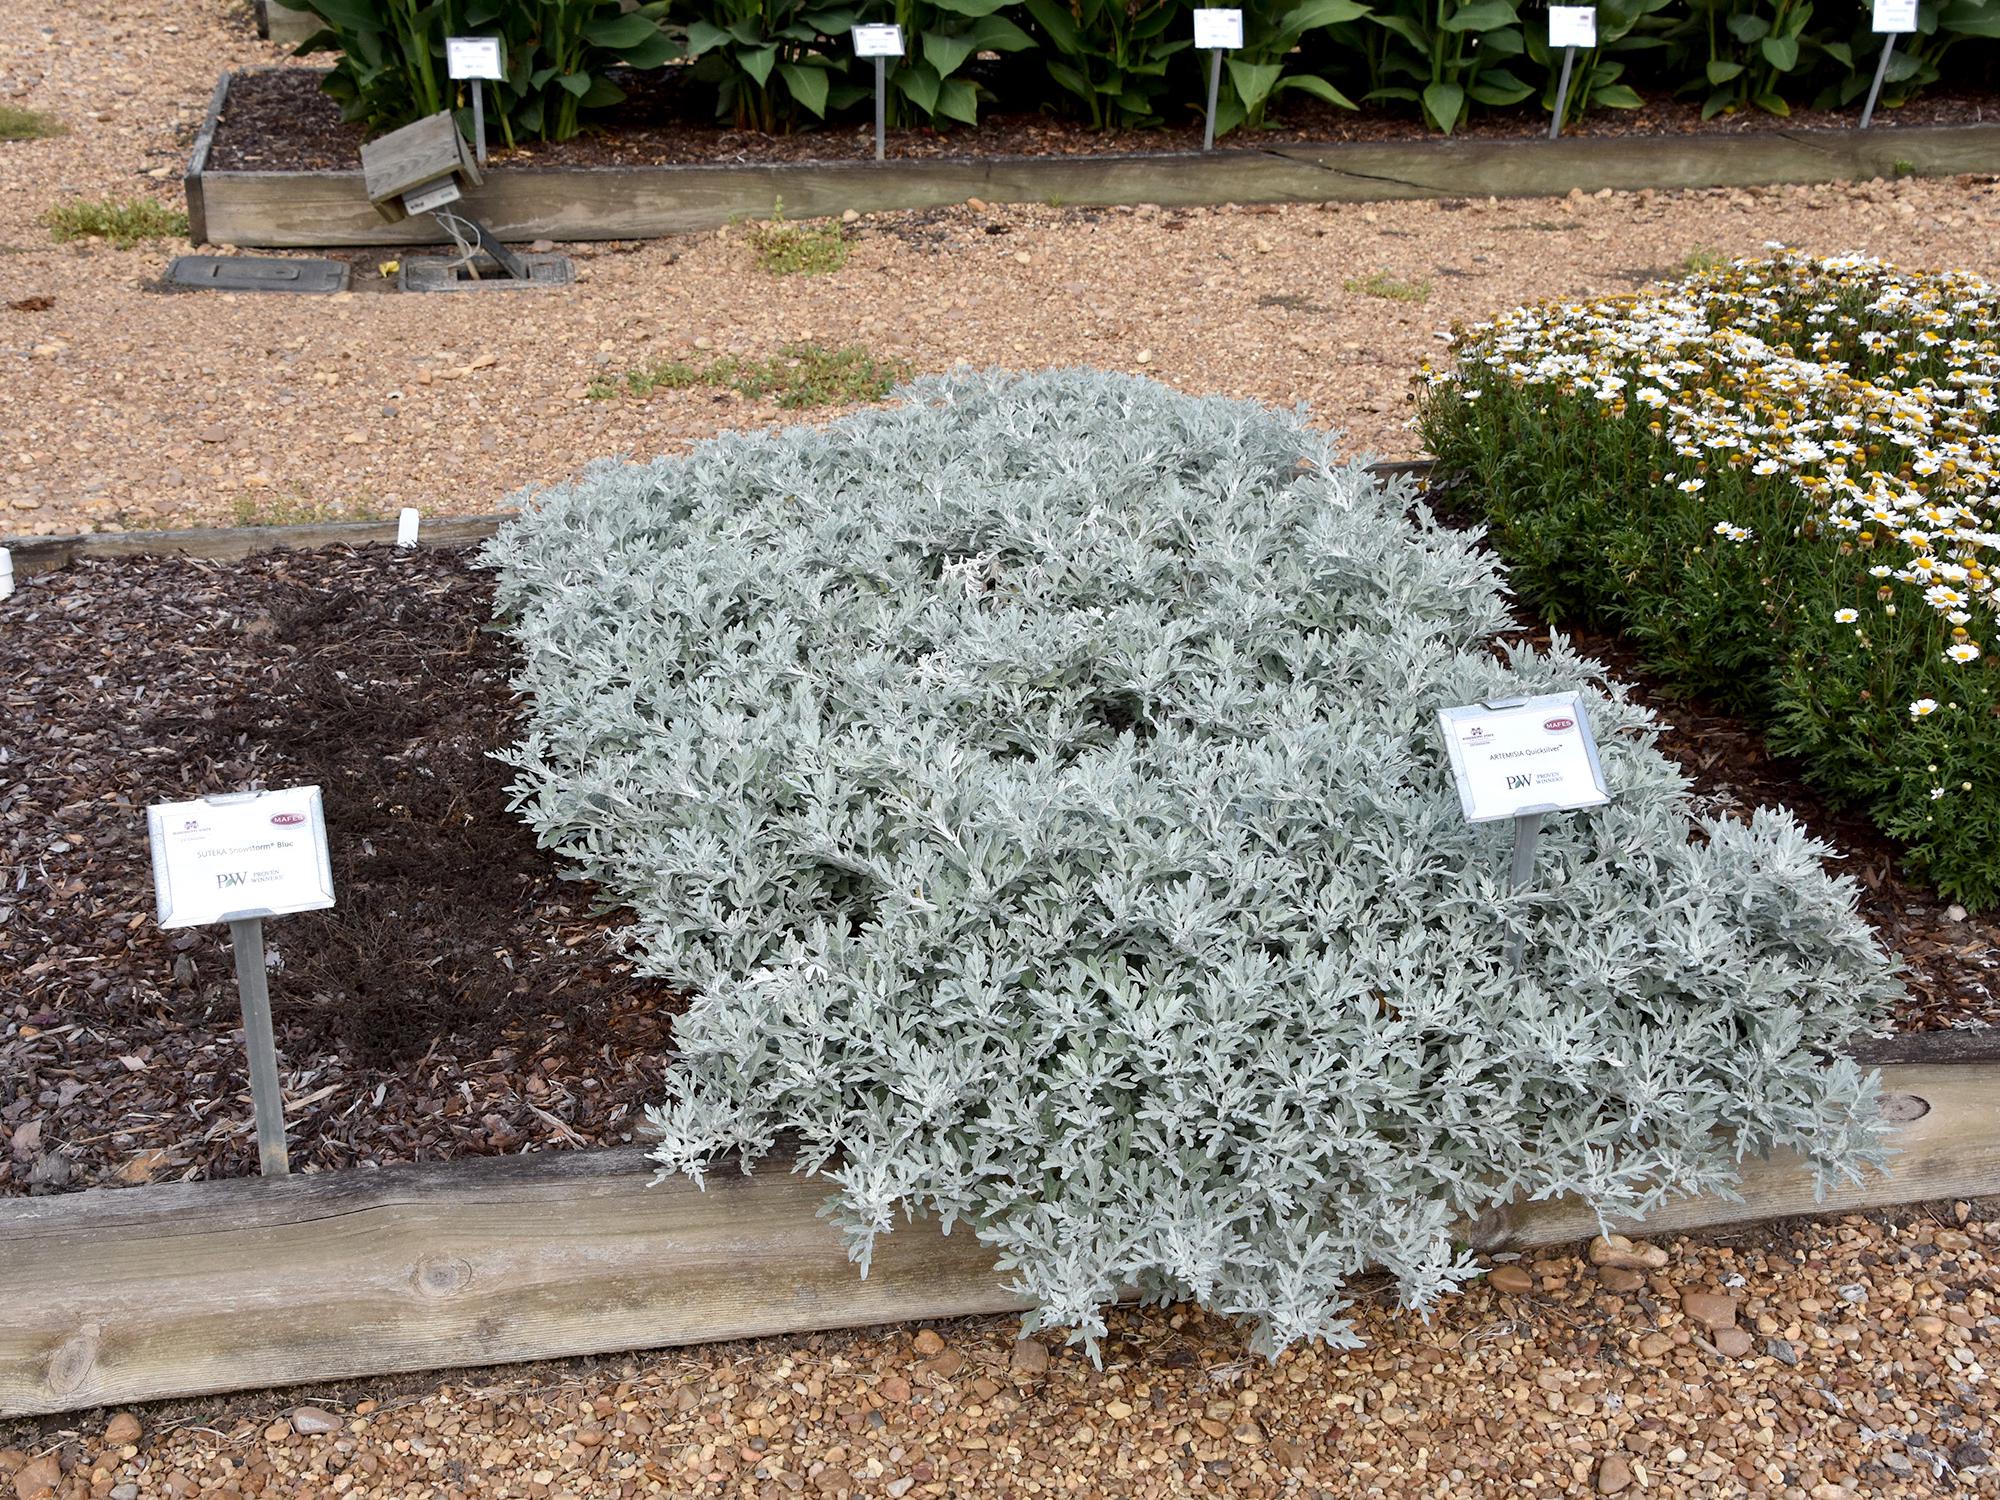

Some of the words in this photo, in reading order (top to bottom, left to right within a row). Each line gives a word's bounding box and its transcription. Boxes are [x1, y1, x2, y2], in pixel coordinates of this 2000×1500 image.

[1546, 720, 1572, 729] MAFES
[1490, 750, 1524, 760] ARTEMISIA
[274, 815, 305, 823] MAFES
[197, 848, 227, 858] SUTERA
